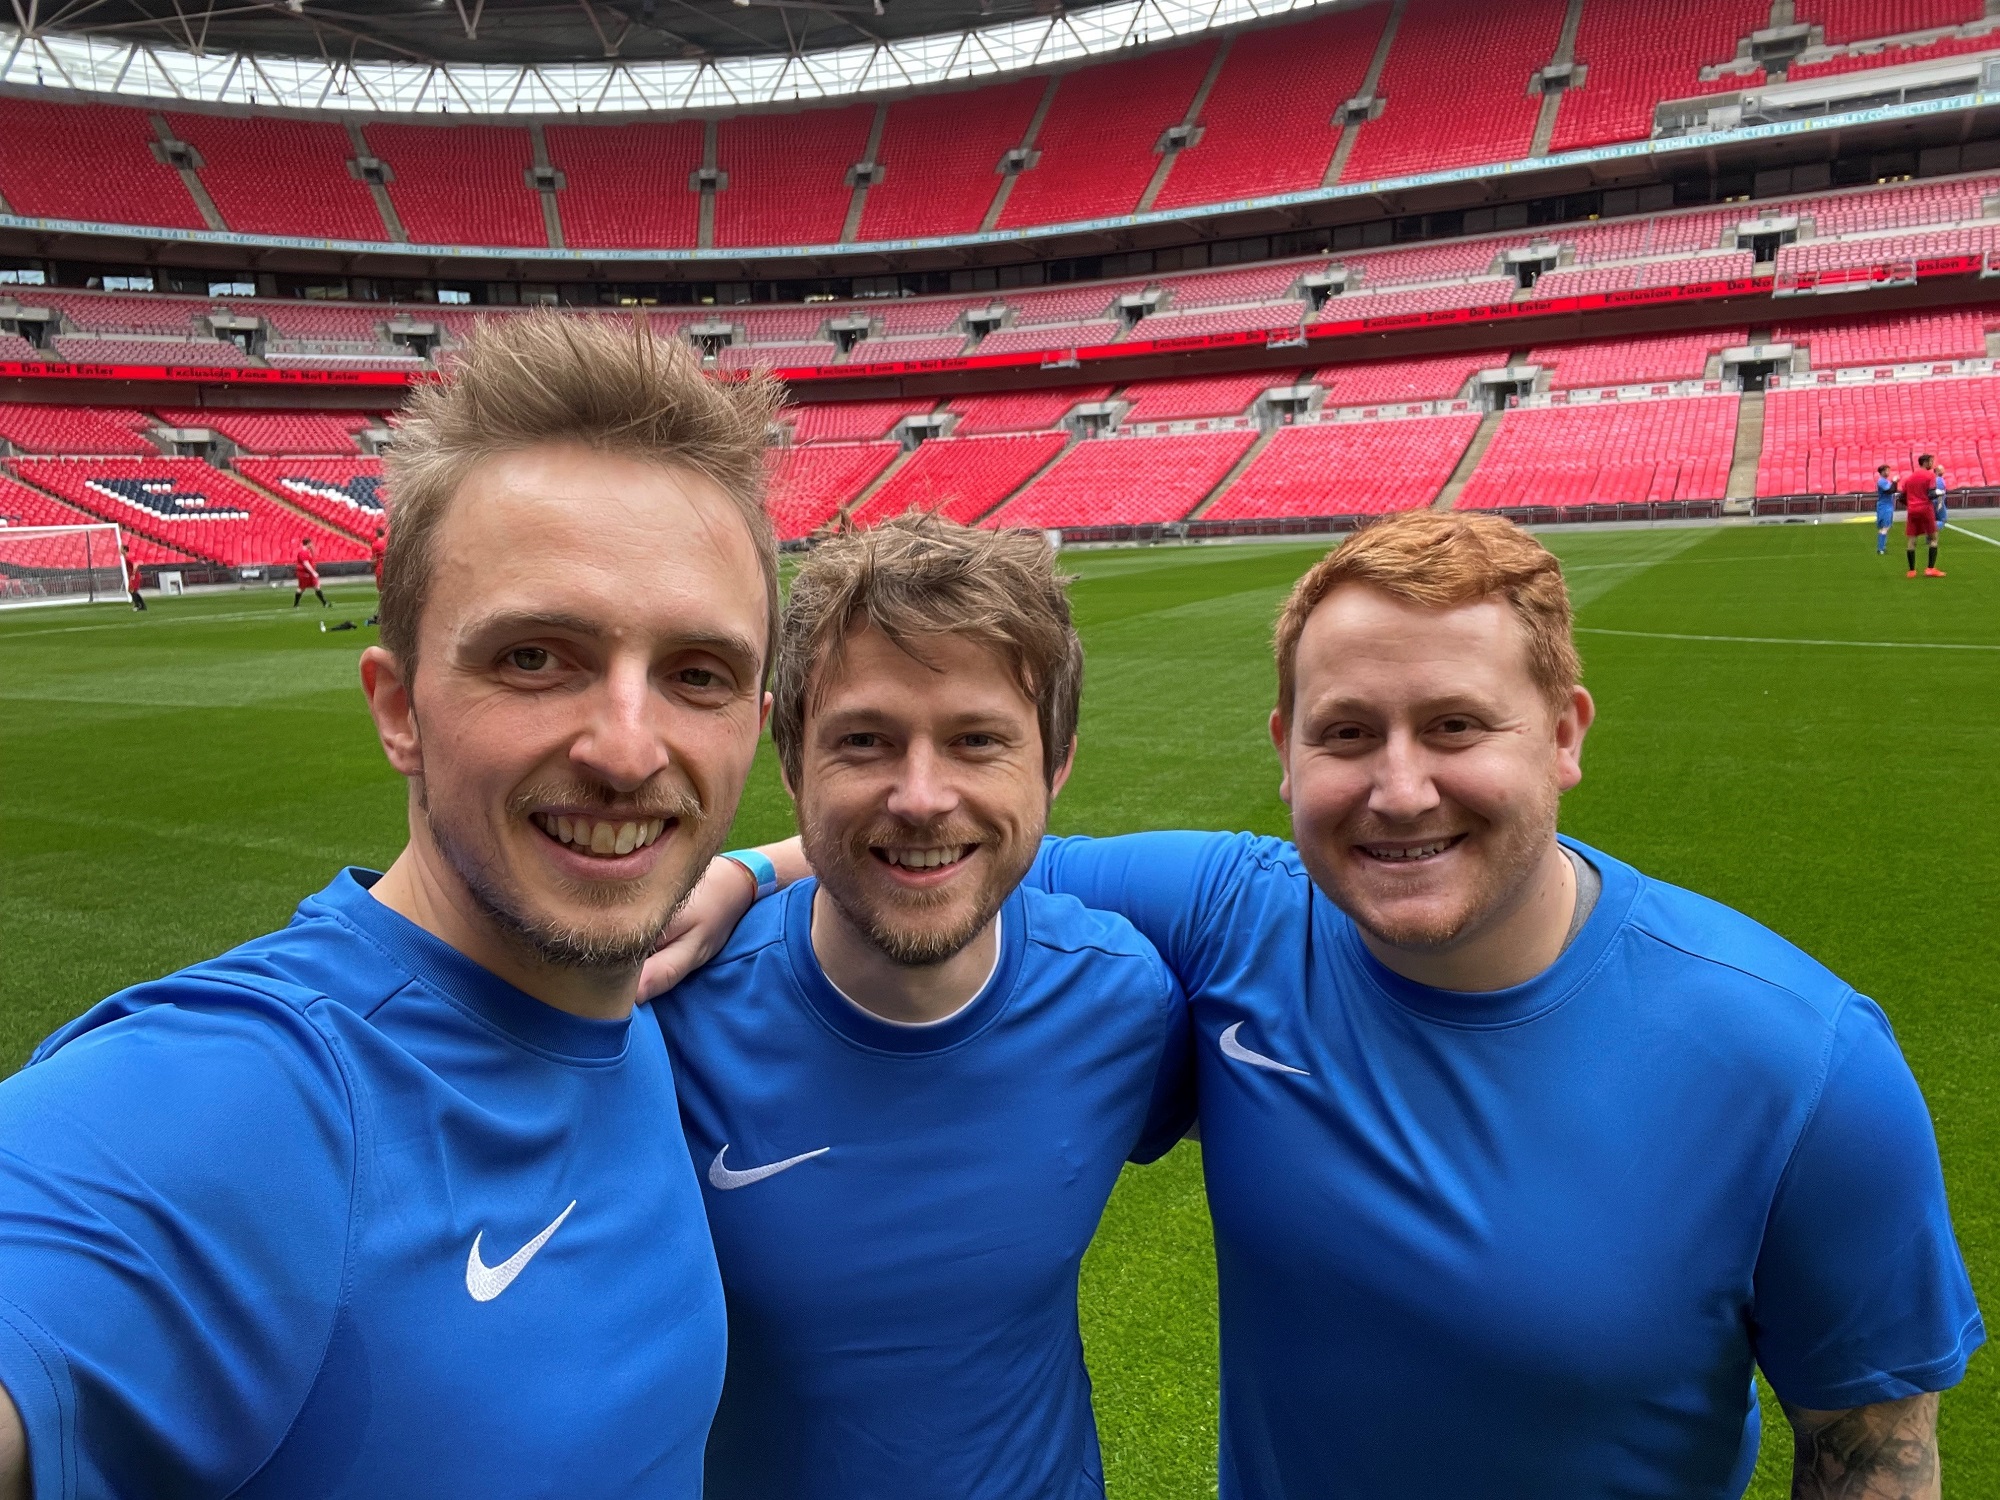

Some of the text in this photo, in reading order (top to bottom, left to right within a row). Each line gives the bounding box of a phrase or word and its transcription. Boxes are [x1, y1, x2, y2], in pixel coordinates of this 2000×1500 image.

[1811, 113, 1867, 128] WEMBLEY
[1655, 136, 1706, 151] WEMBLEY
[1604, 288, 1672, 303] Exclusion
[1677, 284, 1713, 297] Zone
[1727, 279, 1746, 291] Do
[1490, 303, 1512, 315] Not
[1517, 301, 1553, 313] Enter
[21, 363, 41, 374] Do
[45, 363, 71, 375] Not
[76, 364, 114, 377] Enter
